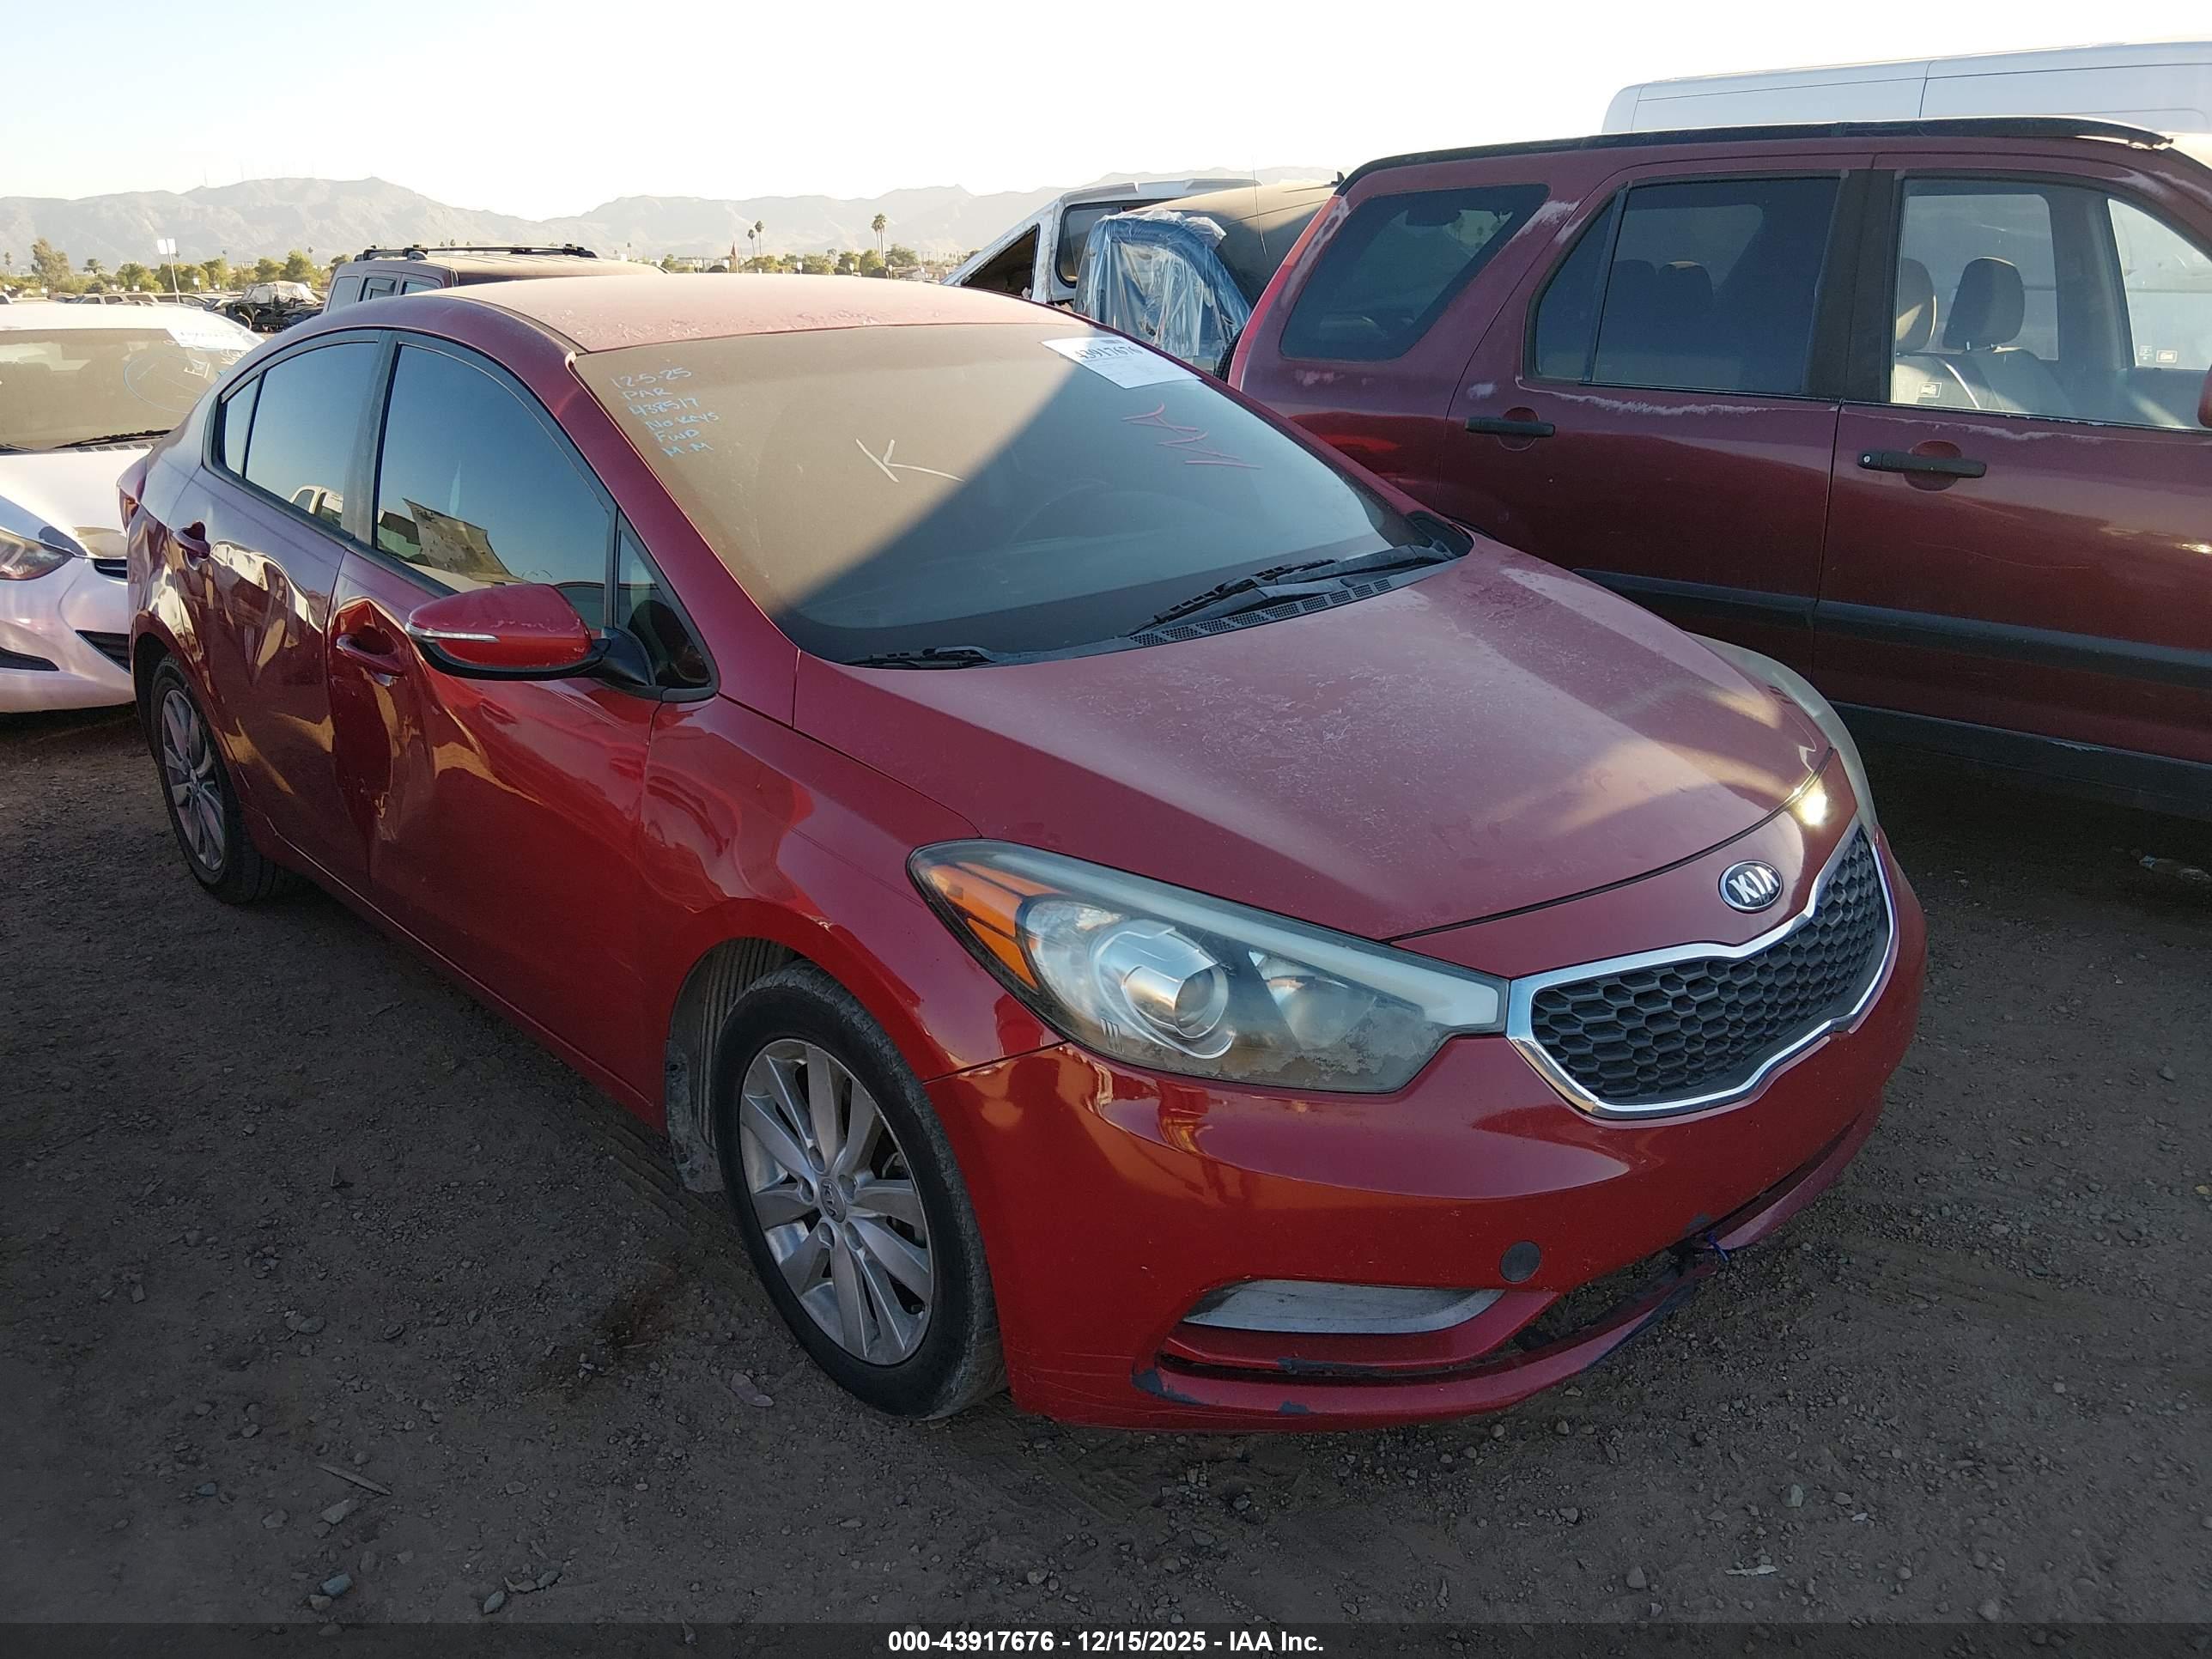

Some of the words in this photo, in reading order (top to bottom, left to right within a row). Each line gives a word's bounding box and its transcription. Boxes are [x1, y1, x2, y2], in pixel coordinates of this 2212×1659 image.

[1073, 345, 1144, 359] 43917676
[609, 367, 693, 389] 12-5-25
[623, 387, 674, 401] PAR
[1728, 865, 1779, 904] KIA
